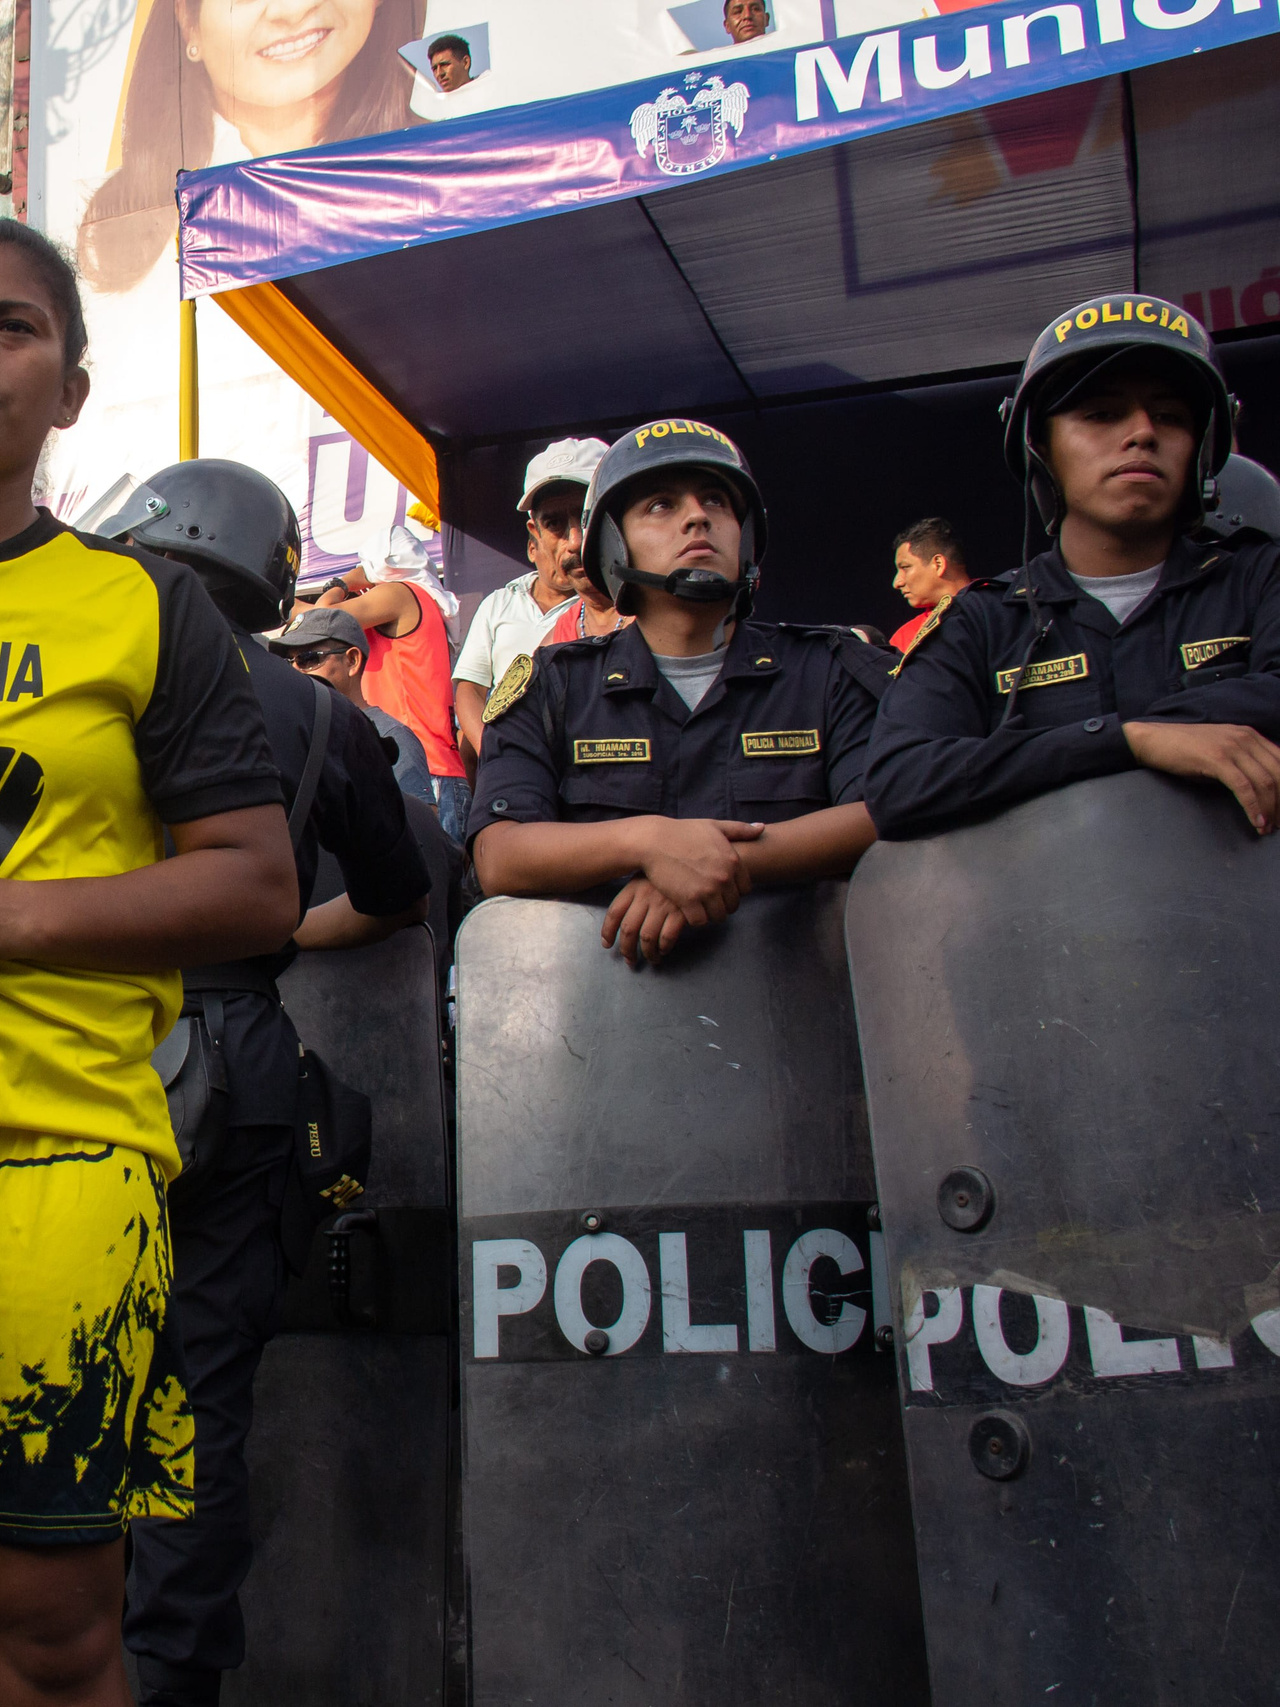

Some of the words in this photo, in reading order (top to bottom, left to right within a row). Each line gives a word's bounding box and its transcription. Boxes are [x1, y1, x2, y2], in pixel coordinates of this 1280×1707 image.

[1054, 301, 1189, 344] POLICIA
[595, 743, 631, 752] HUAMAN
[747, 737, 775, 749] POLICIA
[778, 735, 815, 748] NACIONAL
[307, 1122, 321, 1157] PERU
